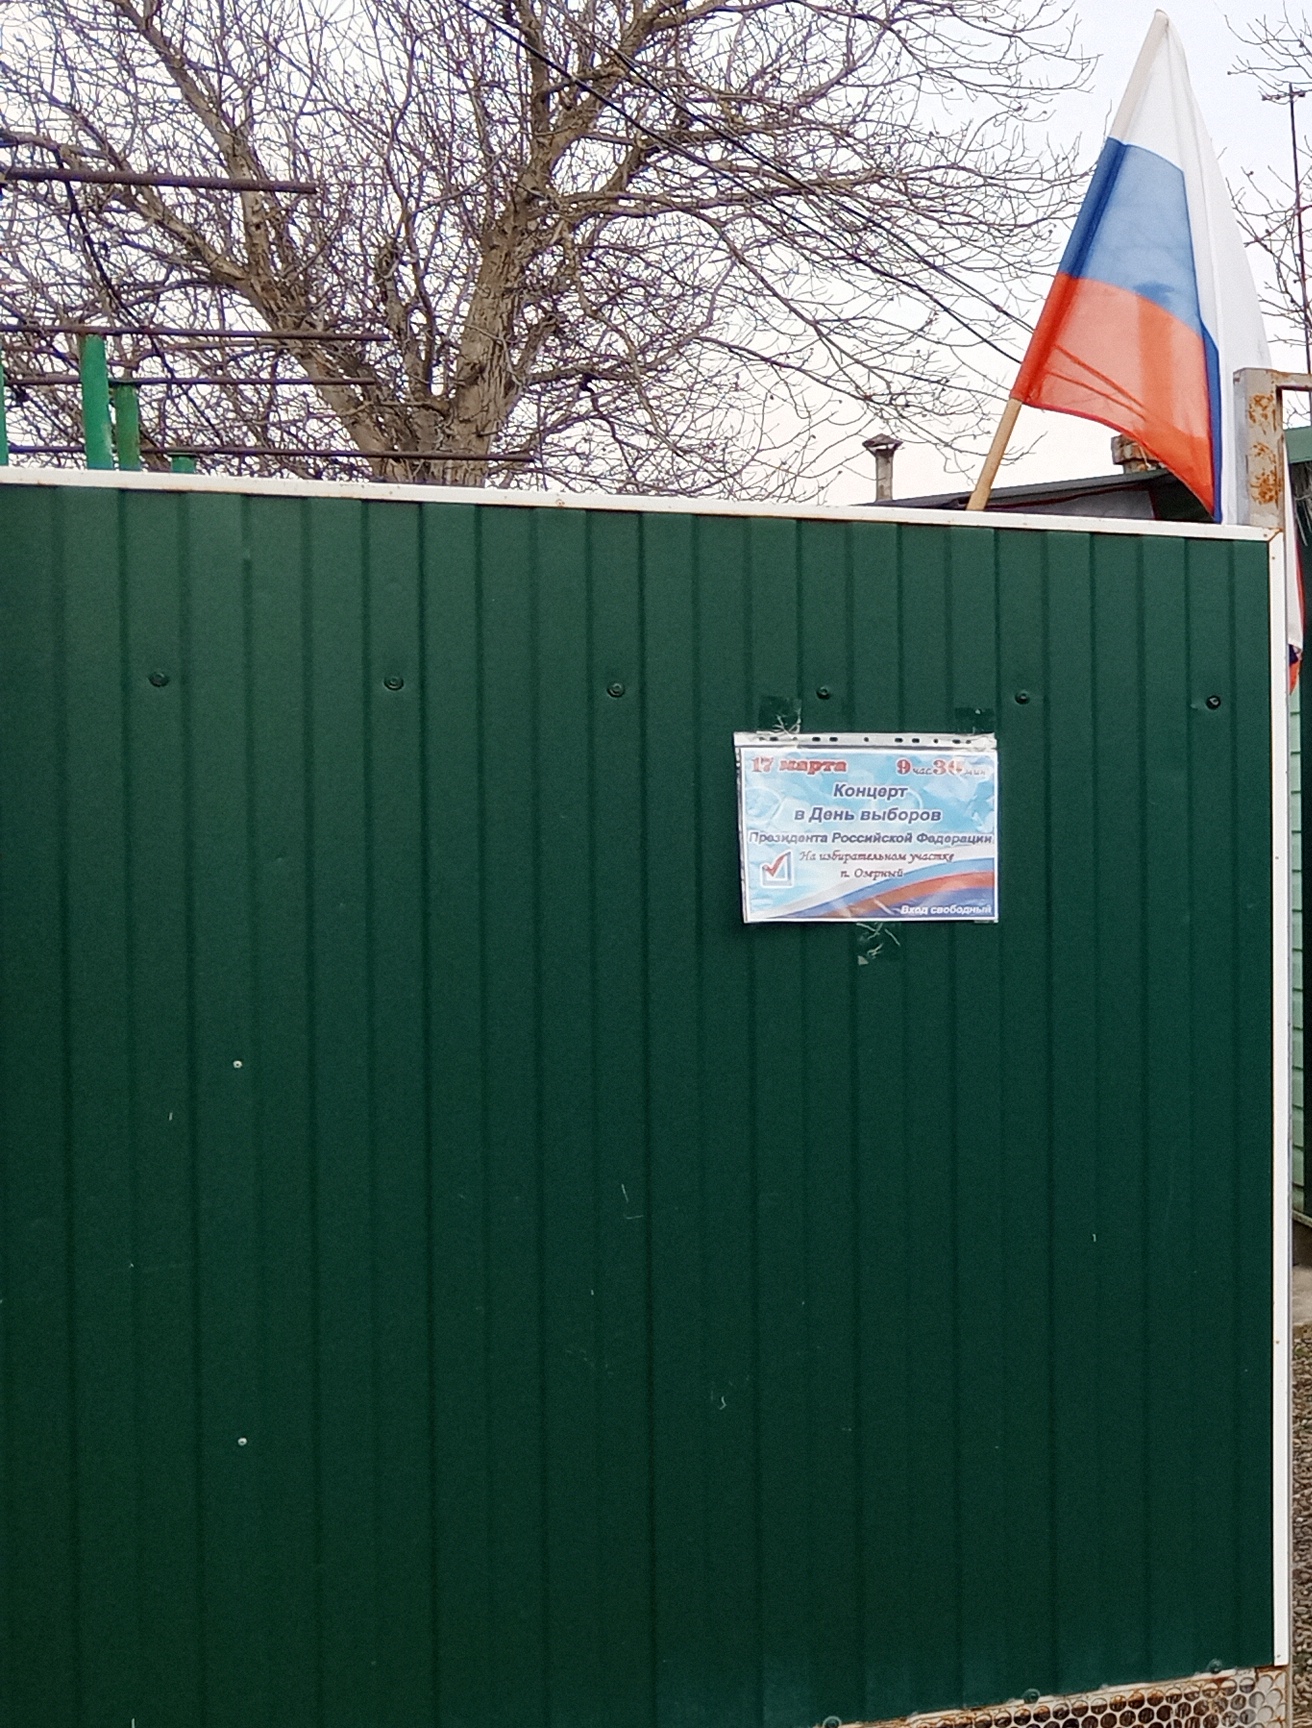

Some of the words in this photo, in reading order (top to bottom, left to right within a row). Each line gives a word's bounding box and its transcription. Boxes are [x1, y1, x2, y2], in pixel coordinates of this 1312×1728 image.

[752, 757, 774, 773] 17
[779, 758, 847, 774] марта
[833, 783, 908, 799] Концерт
[808, 807, 855, 823] День
[860, 807, 942, 823] выборов
[749, 832, 827, 845] Президента
[832, 831, 912, 844] Российской
[916, 832, 992, 845] Федерации
[799, 850, 816, 861] На
[819, 850, 906, 863] избирательном
[909, 852, 954, 864] участке
[901, 905, 929, 916] Вход
